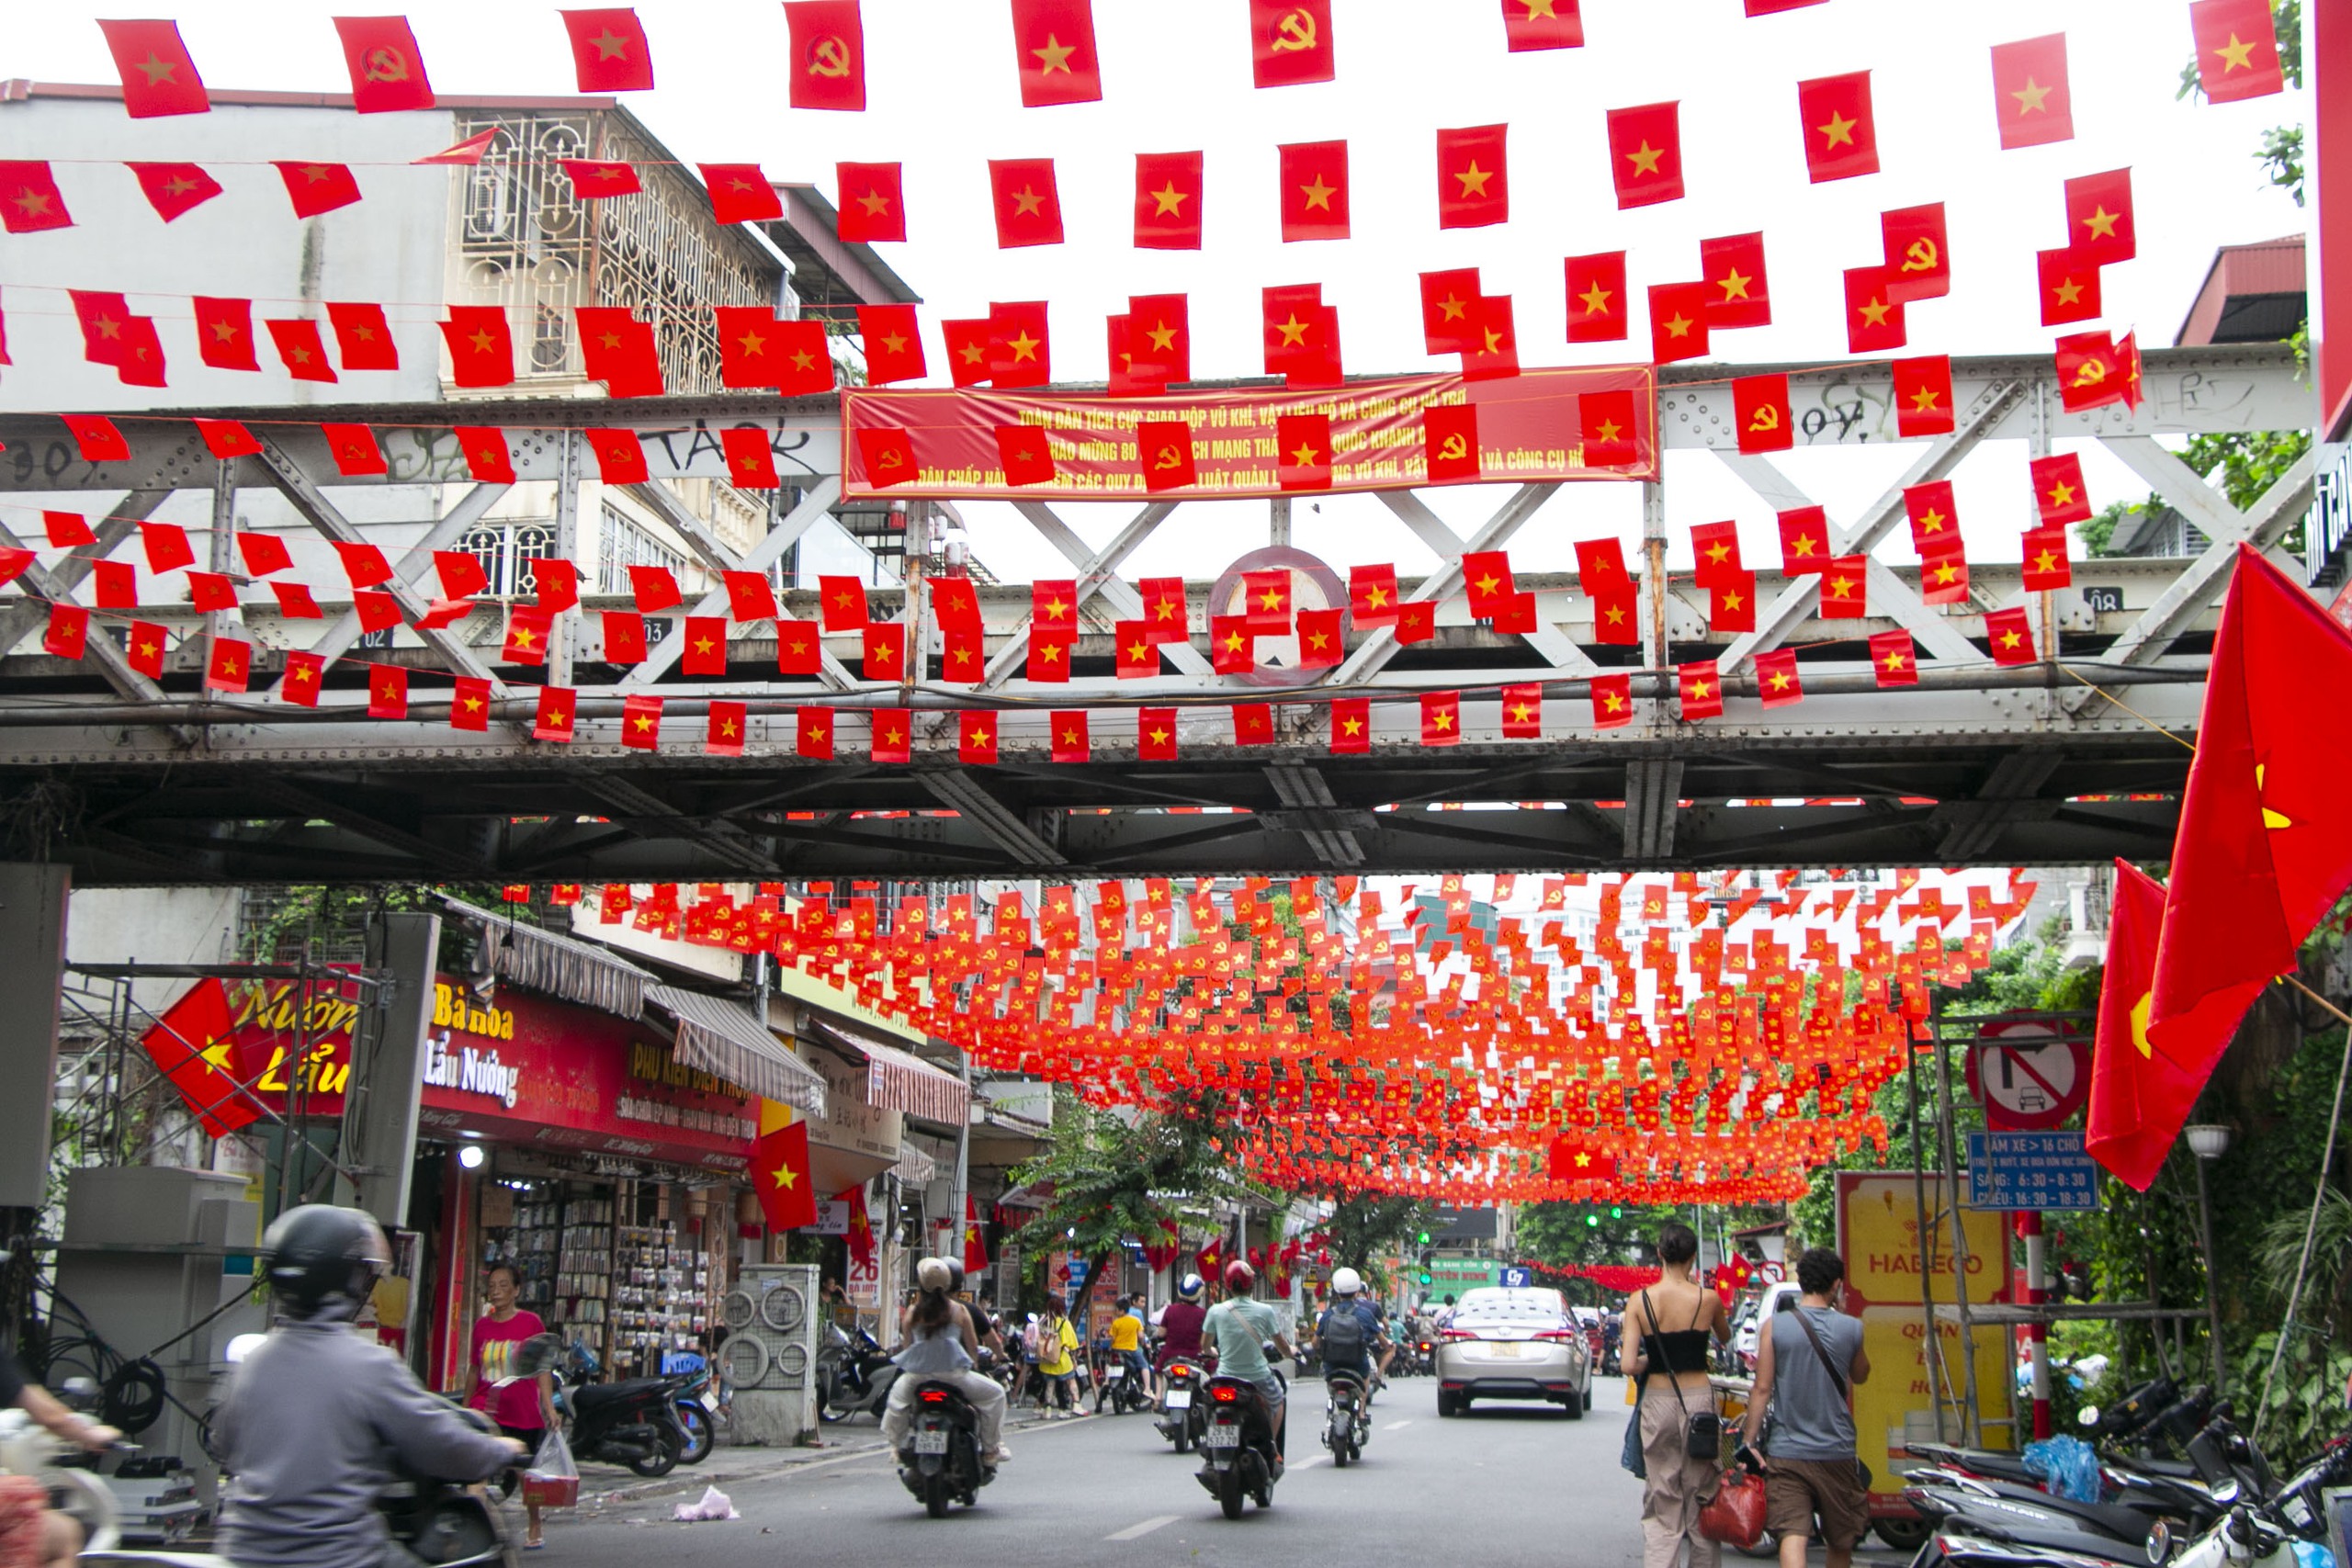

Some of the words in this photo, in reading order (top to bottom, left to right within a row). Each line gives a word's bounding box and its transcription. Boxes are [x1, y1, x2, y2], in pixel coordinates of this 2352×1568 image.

[1056, 408, 1082, 429] DÂN
[1086, 408, 1114, 429] TÍCH
[1181, 406, 1206, 433] NỘP
[1210, 405, 1227, 427] VŨ
[1230, 404, 1256, 428] KHÍ,
[1260, 402, 1283, 430] VẬT
[1340, 398, 1357, 421] VÀ
[1361, 396, 1396, 420] CÔNG
[1399, 397, 1417, 419] CỤ
[1048, 437, 1075, 461] HÀO
[1080, 438, 1117, 461] MỪNG
[1122, 442, 1137, 461] 80
[1192, 440, 1208, 460] CH
[1212, 438, 1250, 463] MẠNG
[1254, 434, 1279, 457] THÁ
[1332, 425, 1367, 454] QUỐC
[1371, 424, 1415, 449] KHÁNH
[917, 466, 944, 487] DÂN
[948, 463, 981, 487] CHẤP
[1077, 469, 1102, 490] CÁC
[1105, 474, 1131, 491] QUY
[1198, 468, 1229, 491] LUẬT
[1233, 463, 1269, 488] QUẢN
[1331, 465, 1351, 482] NG
[1355, 459, 1372, 480] VŨ
[1486, 447, 1504, 470] VÀ
[1507, 446, 1544, 470] CÔNG
[1547, 448, 1566, 473] CỤ
[233, 985, 359, 1035] Nướn
[433, 983, 467, 1031] Bà
[257, 1043, 351, 1095] Lẩu
[424, 1030, 459, 1088] Lẩu
[461, 1048, 519, 1109] Nướng
[2013, 1137, 2027, 1152] XE
[2042, 1138, 2052, 1152] 16
